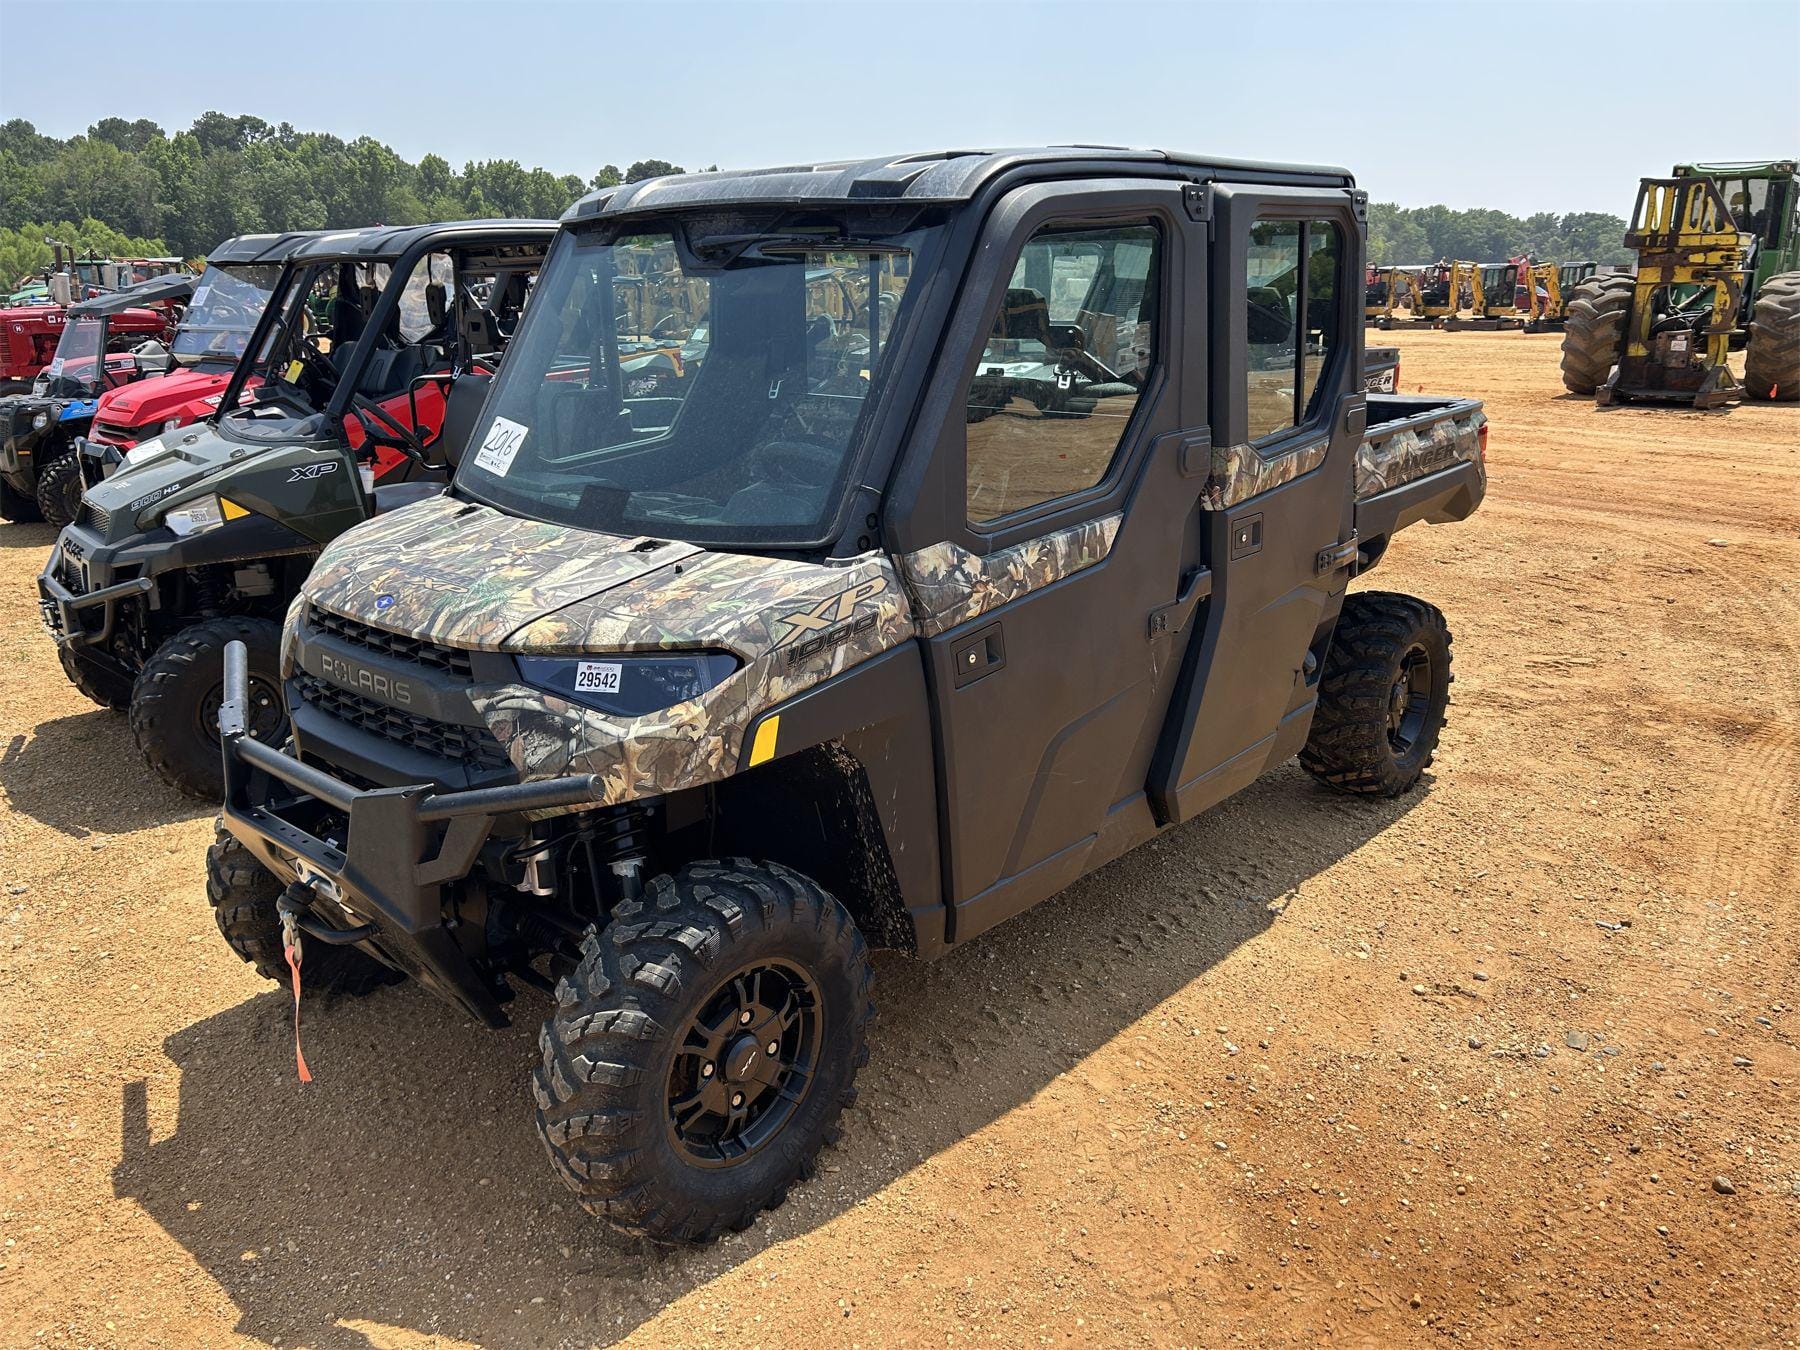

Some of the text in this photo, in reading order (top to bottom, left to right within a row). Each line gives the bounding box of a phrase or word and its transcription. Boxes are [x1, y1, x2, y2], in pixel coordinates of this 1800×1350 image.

[1364, 375, 1392, 387] NGER
[286, 461, 338, 482] XP
[1385, 443, 1456, 480] RANGER
[131, 489, 161, 511] 900
[760, 575, 890, 657] XP
[787, 611, 880, 666] 1000
[321, 654, 411, 704] POLARIS
[578, 671, 617, 689] 29542
